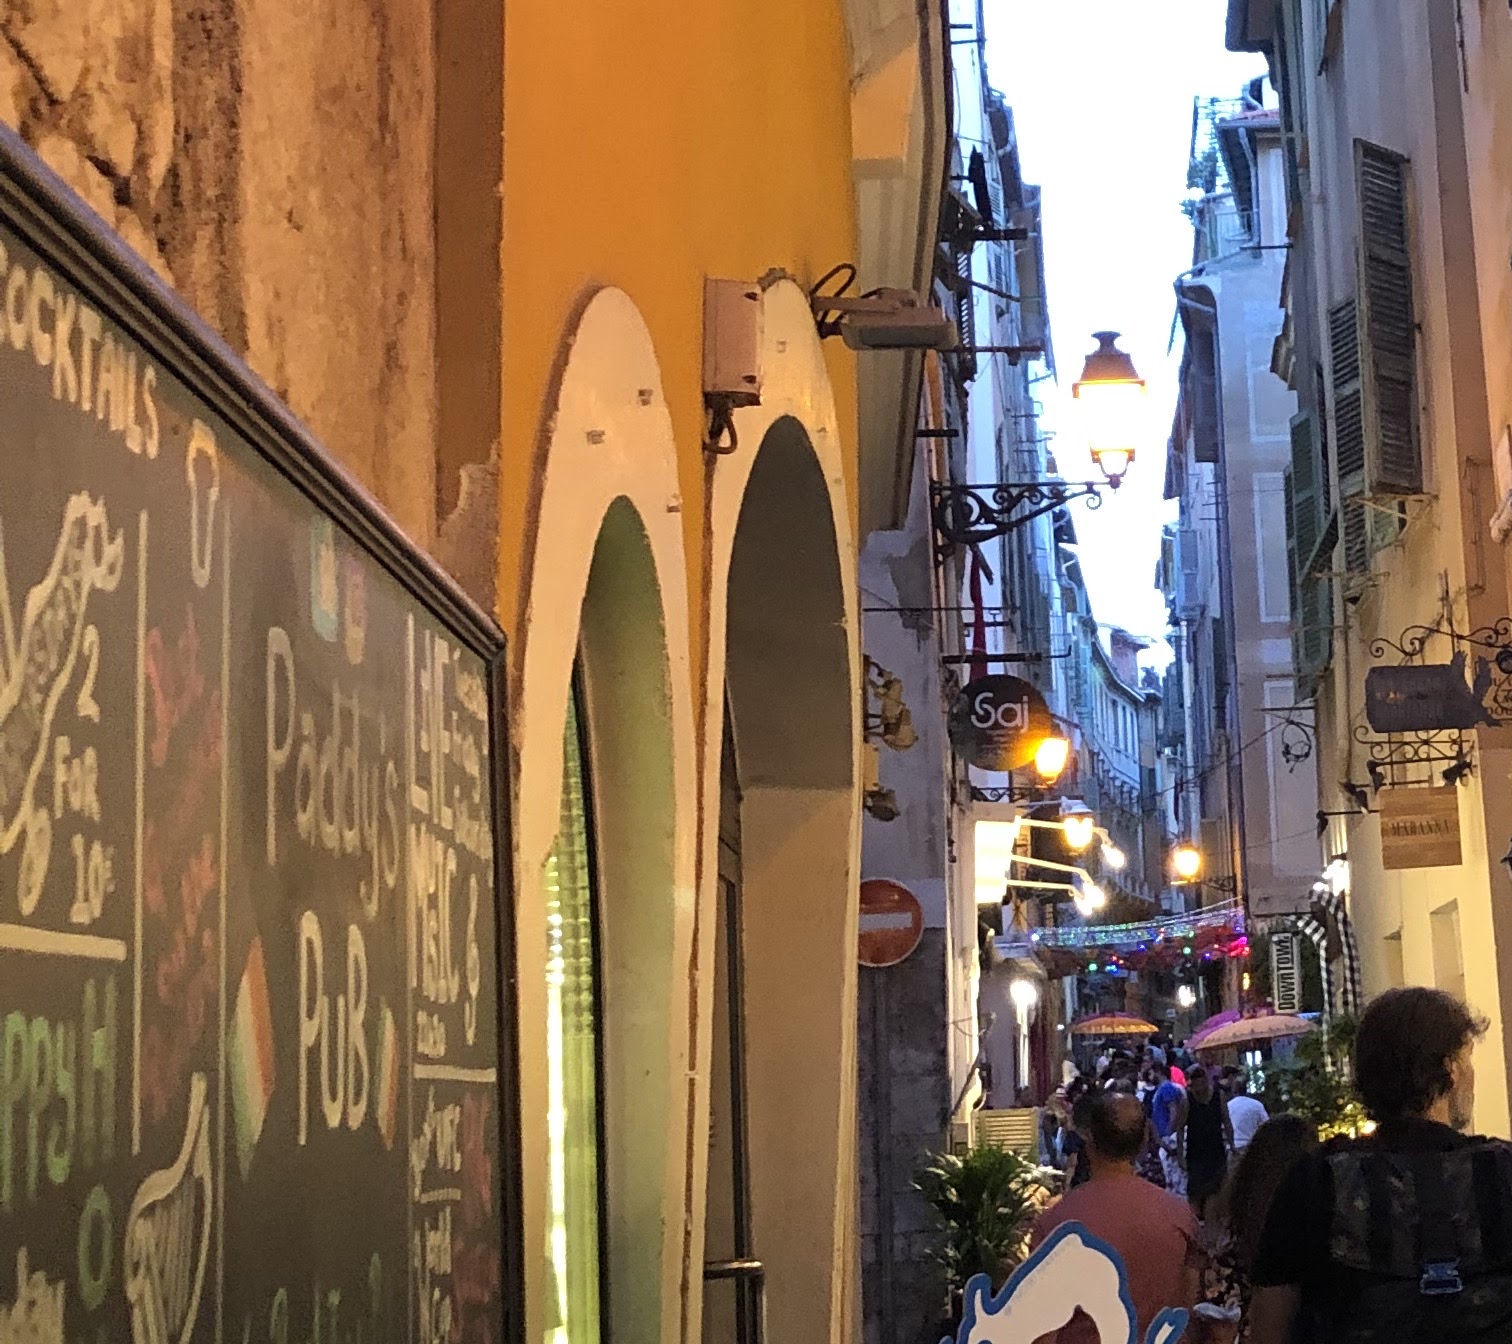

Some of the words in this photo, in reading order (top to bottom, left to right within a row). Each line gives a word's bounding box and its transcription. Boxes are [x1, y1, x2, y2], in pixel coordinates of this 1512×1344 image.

[0, 241, 160, 458] OCKTAILS
[969, 691, 1030, 735] Saj
[299, 910, 367, 1147] PUB
